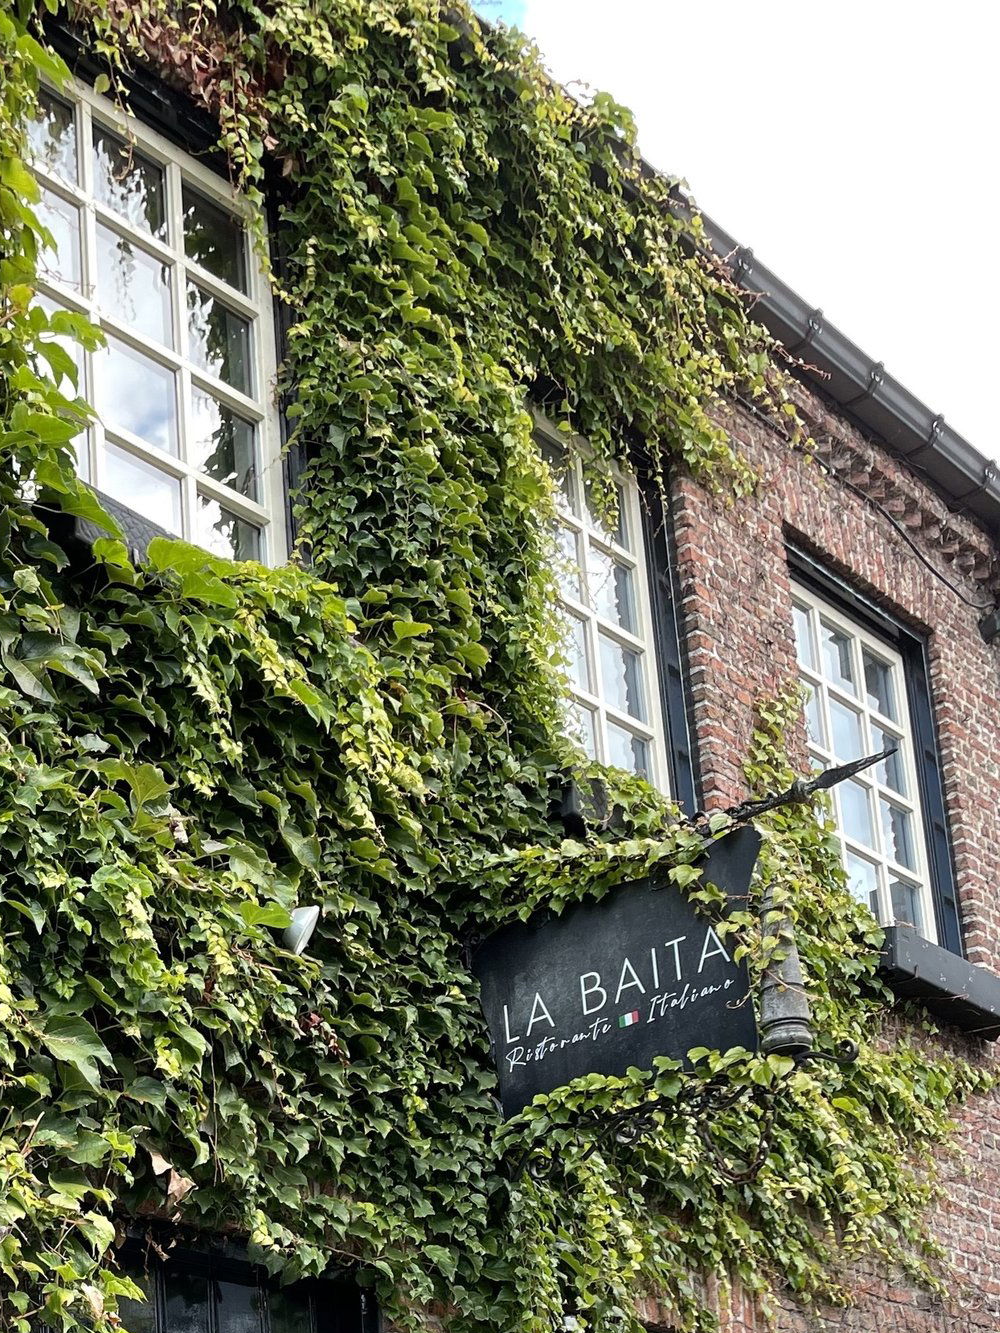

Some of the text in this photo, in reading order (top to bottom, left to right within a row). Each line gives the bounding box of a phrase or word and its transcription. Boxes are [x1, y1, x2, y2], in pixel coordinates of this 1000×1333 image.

[503, 925, 731, 1044] LA BAITA
[505, 978, 735, 1072] Ristorante Italiano
